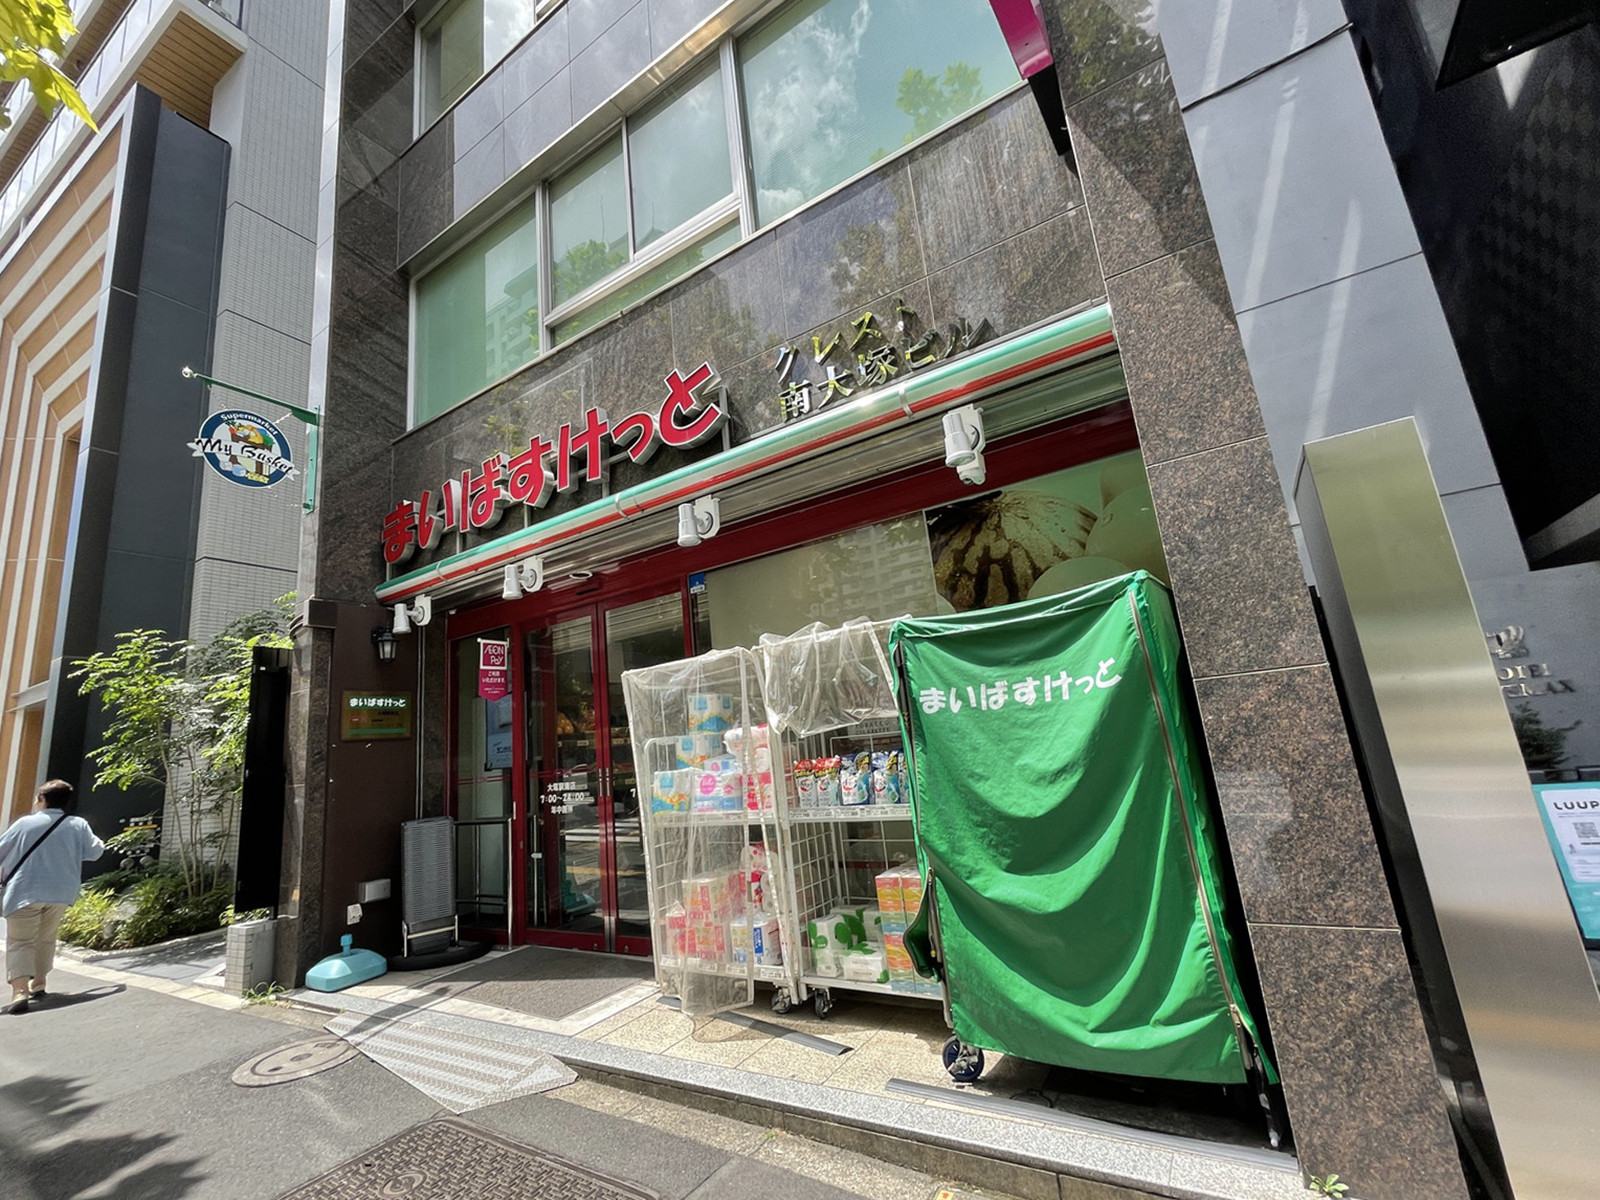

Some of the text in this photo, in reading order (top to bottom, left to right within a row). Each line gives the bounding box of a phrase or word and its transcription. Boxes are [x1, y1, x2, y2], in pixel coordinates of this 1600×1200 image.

[774, 297, 918, 386] クレスト
[220, 412, 278, 436] Supermarket
[195, 437, 293, 475] My Basket
[381, 361, 728, 565] まいばすけっと
[919, 657, 1122, 714] まいばすけっと
[1498, 663, 1553, 681] OTEL
[349, 697, 406, 708] まいばすけっと
[1553, 801, 1600, 811] LUUP
